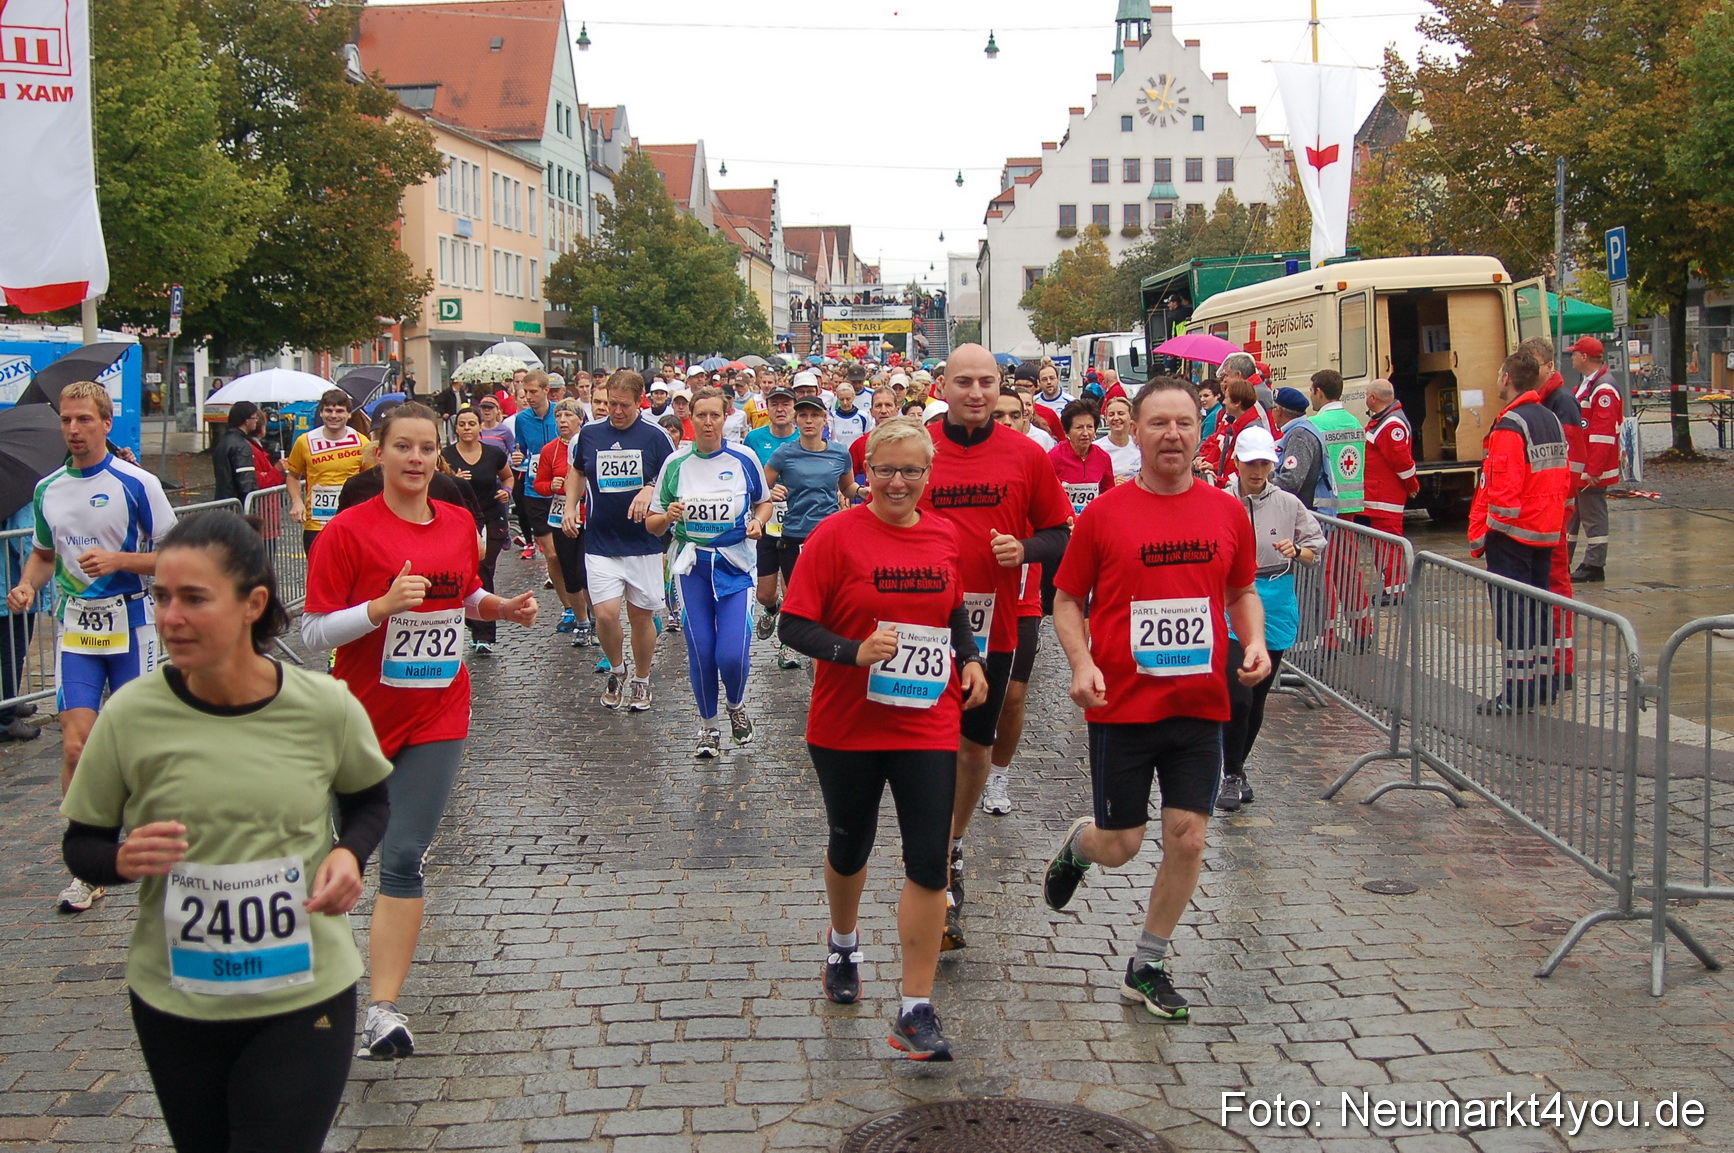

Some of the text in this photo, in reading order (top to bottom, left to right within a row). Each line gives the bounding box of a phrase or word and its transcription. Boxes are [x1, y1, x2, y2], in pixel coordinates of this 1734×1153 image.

[1610, 236, 1620, 275] P
[442, 301, 458, 318] D
[852, 323, 882, 332] START
[1266, 312, 1314, 338] Bayerisches
[1265, 341, 1288, 359] Rotes
[1270, 365, 1287, 381] reuz
[311, 454, 334, 465] MAX
[601, 460, 638, 476] 2542
[1066, 492, 1095, 505] 139
[687, 504, 730, 521] 2812
[65, 535, 100, 546] Willem
[1145, 553, 1164, 564] RUN
[1165, 551, 1181, 563] FOR
[878, 578, 898, 590] RUN
[900, 578, 916, 589] FOR
[1132, 606, 1198, 616] PARTL Neumarkt
[78, 611, 114, 632] 431
[390, 616, 452, 627] PARTL Neumarkt
[907, 631, 939, 643] Neumarkt
[1140, 617, 1205, 647] 2682
[80, 636, 111, 647] Willem
[393, 627, 457, 657] 2732
[880, 645, 944, 677] 2733
[1156, 653, 1191, 665] Günter
[405, 665, 442, 677] Nadine
[892, 681, 928, 696] Andrea
[171, 873, 279, 891] PARTL Neumarkt
[180, 890, 296, 945] 2406
[213, 956, 263, 977] Steffi
